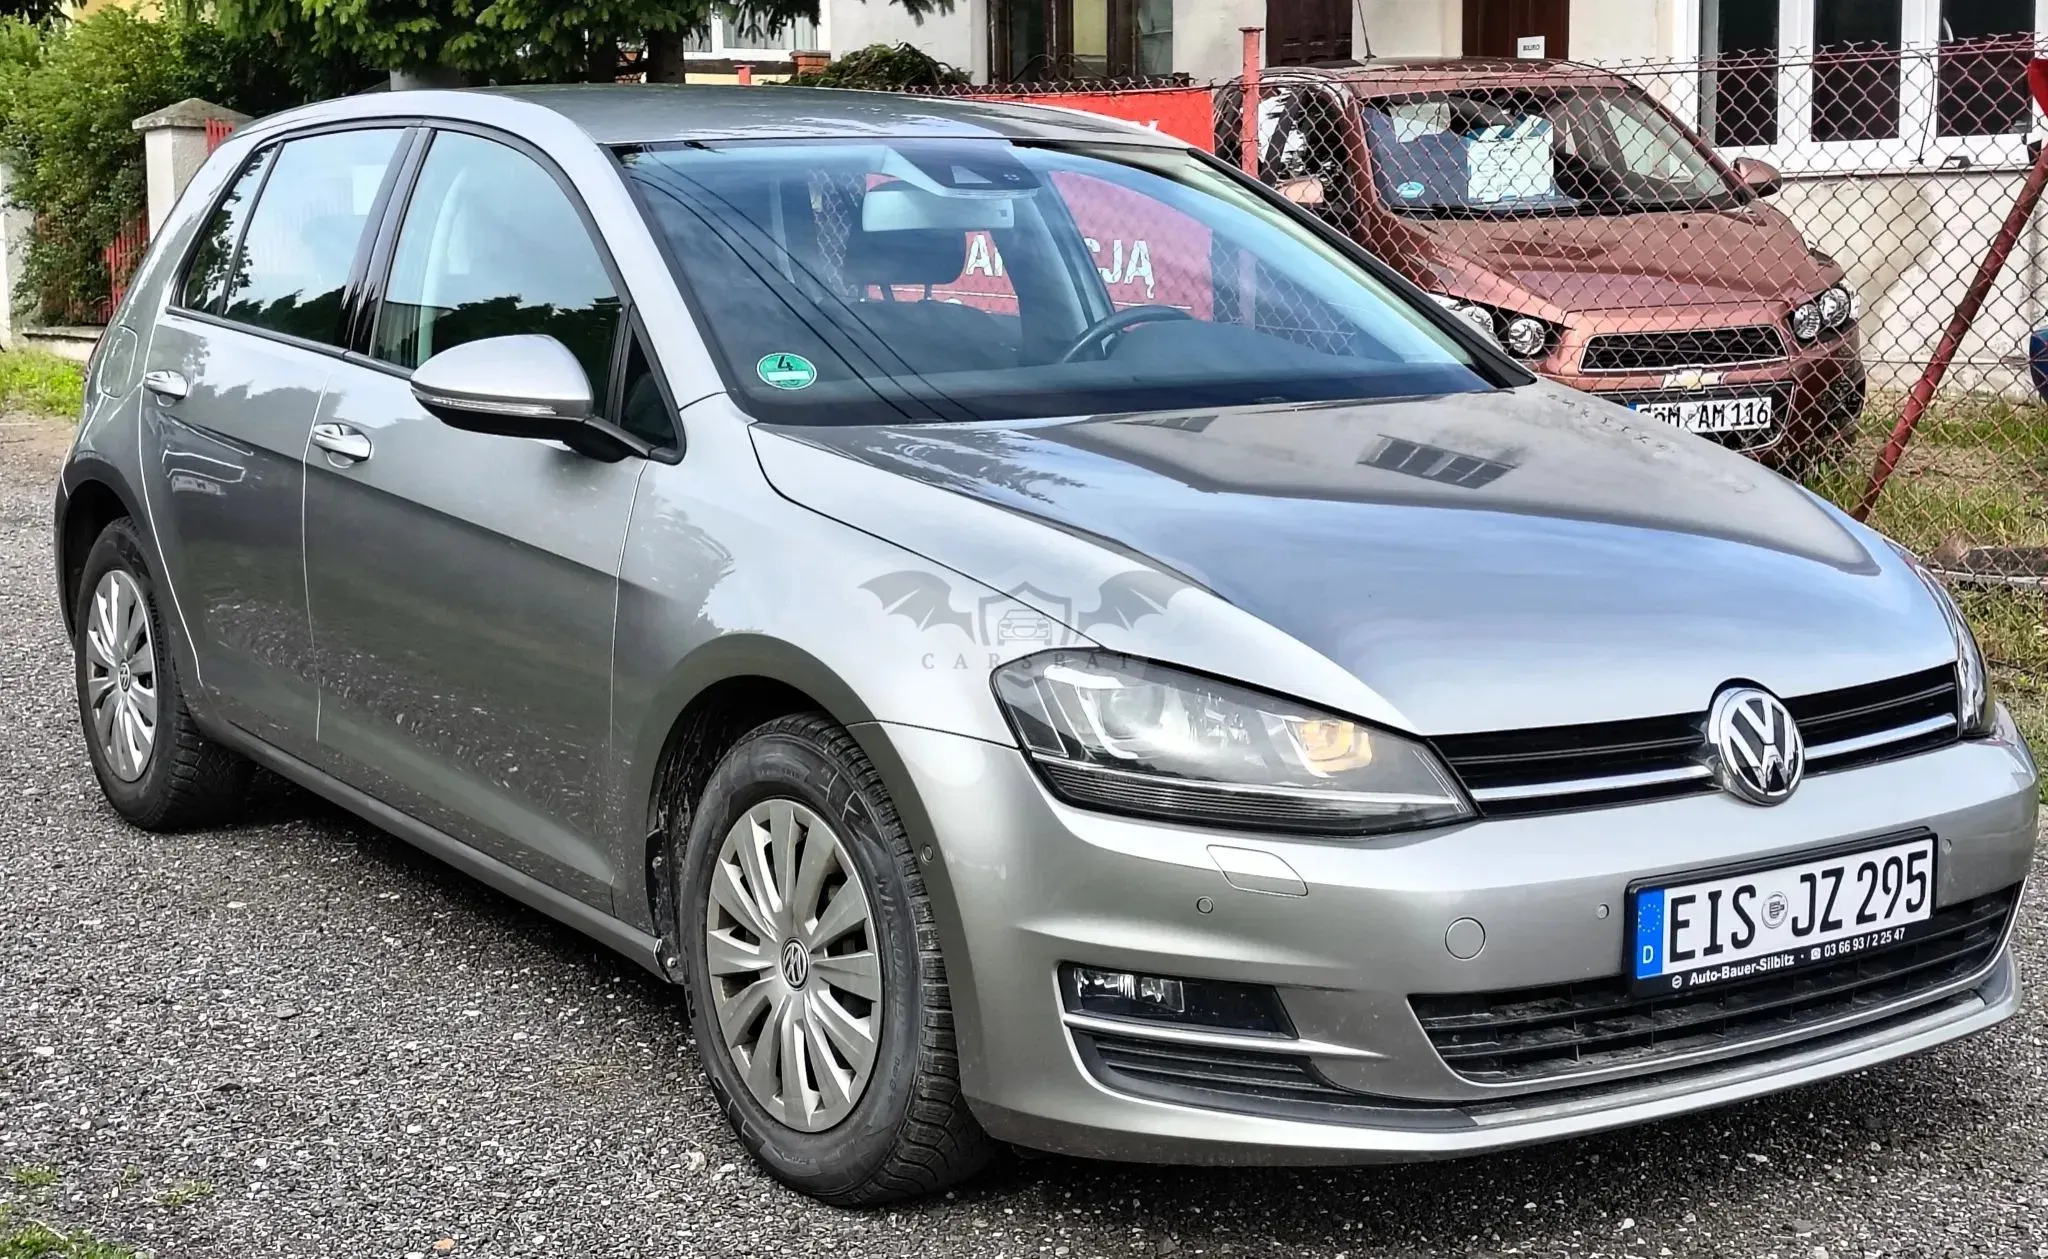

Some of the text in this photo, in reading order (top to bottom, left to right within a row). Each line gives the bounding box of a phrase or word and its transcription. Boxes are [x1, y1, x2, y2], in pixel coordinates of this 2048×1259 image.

[777, 355, 794, 371] 4
[1699, 403, 1726, 428] AM
[1731, 401, 1768, 427] 116
[1642, 849, 1929, 964] D EIS JZ 295
[1689, 953, 1796, 986] Auto-Bauer-Silbitz
[1824, 944, 1836, 958] 03
[1838, 941, 1851, 954] 66
[1852, 937, 1865, 951] 93
[1880, 931, 1892, 944] 25
